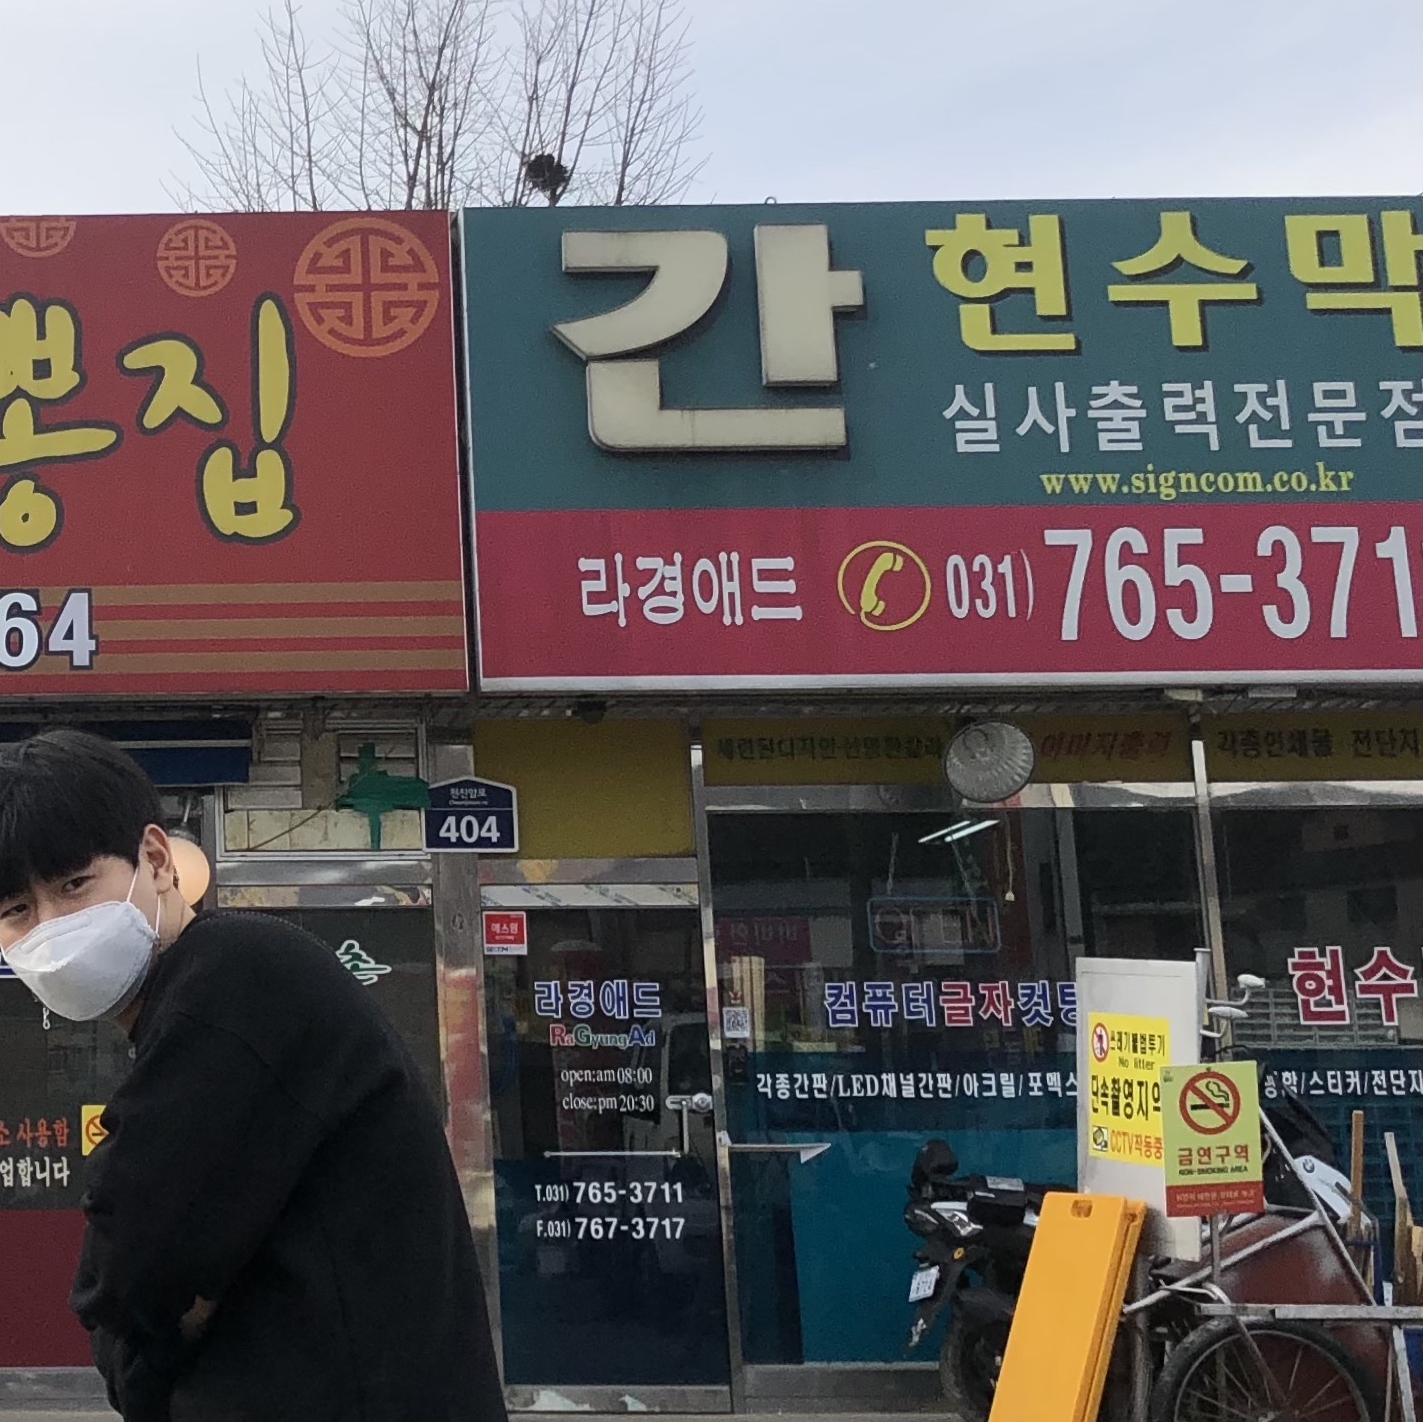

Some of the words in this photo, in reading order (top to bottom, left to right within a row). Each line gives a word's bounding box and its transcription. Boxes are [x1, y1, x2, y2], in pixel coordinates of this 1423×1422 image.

[924, 209, 1423, 352] 현수막
[548, 221, 865, 455] 간
[1039, 461, 1355, 499] www.signcom.co.kr
[578, 551, 803, 627] 라경애드
[439, 815, 500, 843] 404
[534, 980, 662, 1018] 라경애드
[1118, 1056, 1130, 1069] No
[1133, 1057, 1155, 1071] litter
[1178, 1144, 1250, 1166] 금연구역
[1230, 1165, 1249, 1174] AREA
[573, 1181, 683, 1204] 765-3711
[575, 1217, 685, 1240] 767-3717
